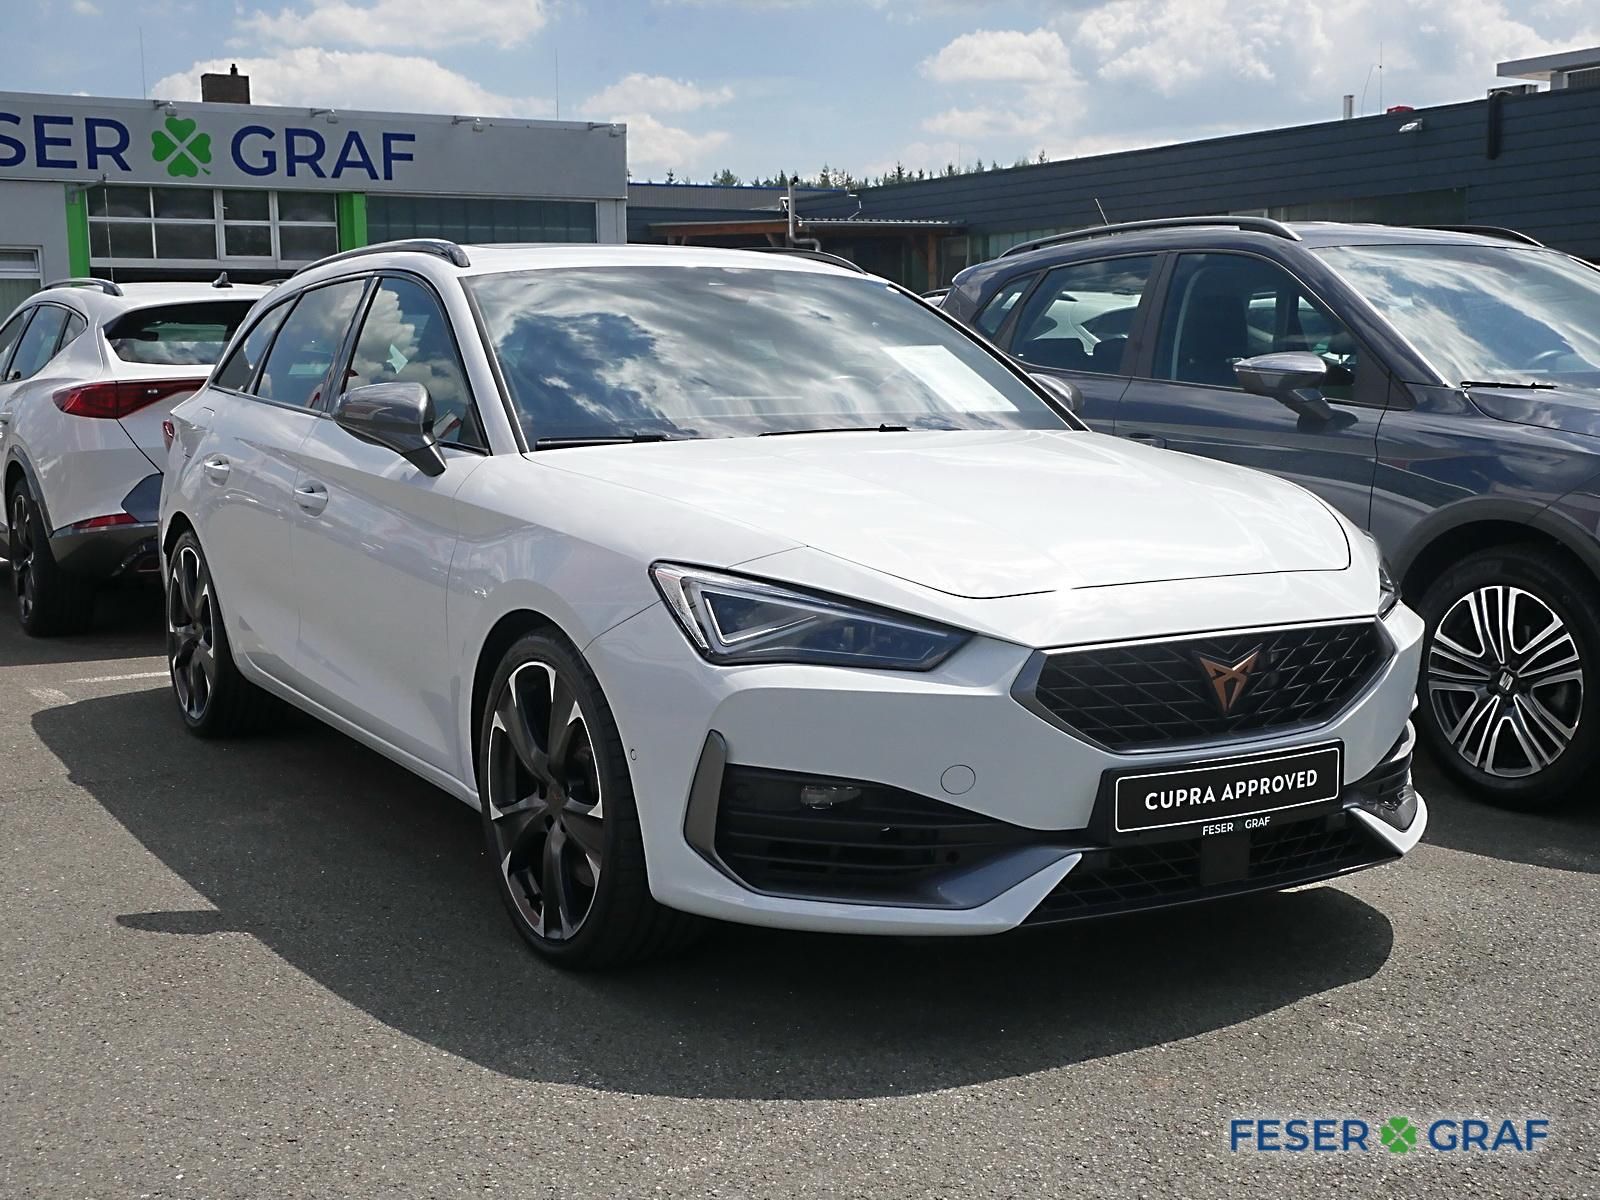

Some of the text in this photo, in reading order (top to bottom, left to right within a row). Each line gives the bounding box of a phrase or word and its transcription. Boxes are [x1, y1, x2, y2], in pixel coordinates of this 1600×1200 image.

[231, 125, 416, 181] GRAF
[1145, 769, 1318, 811] CUPRA APPROVED
[1202, 816, 1271, 836] FESER GRAF
